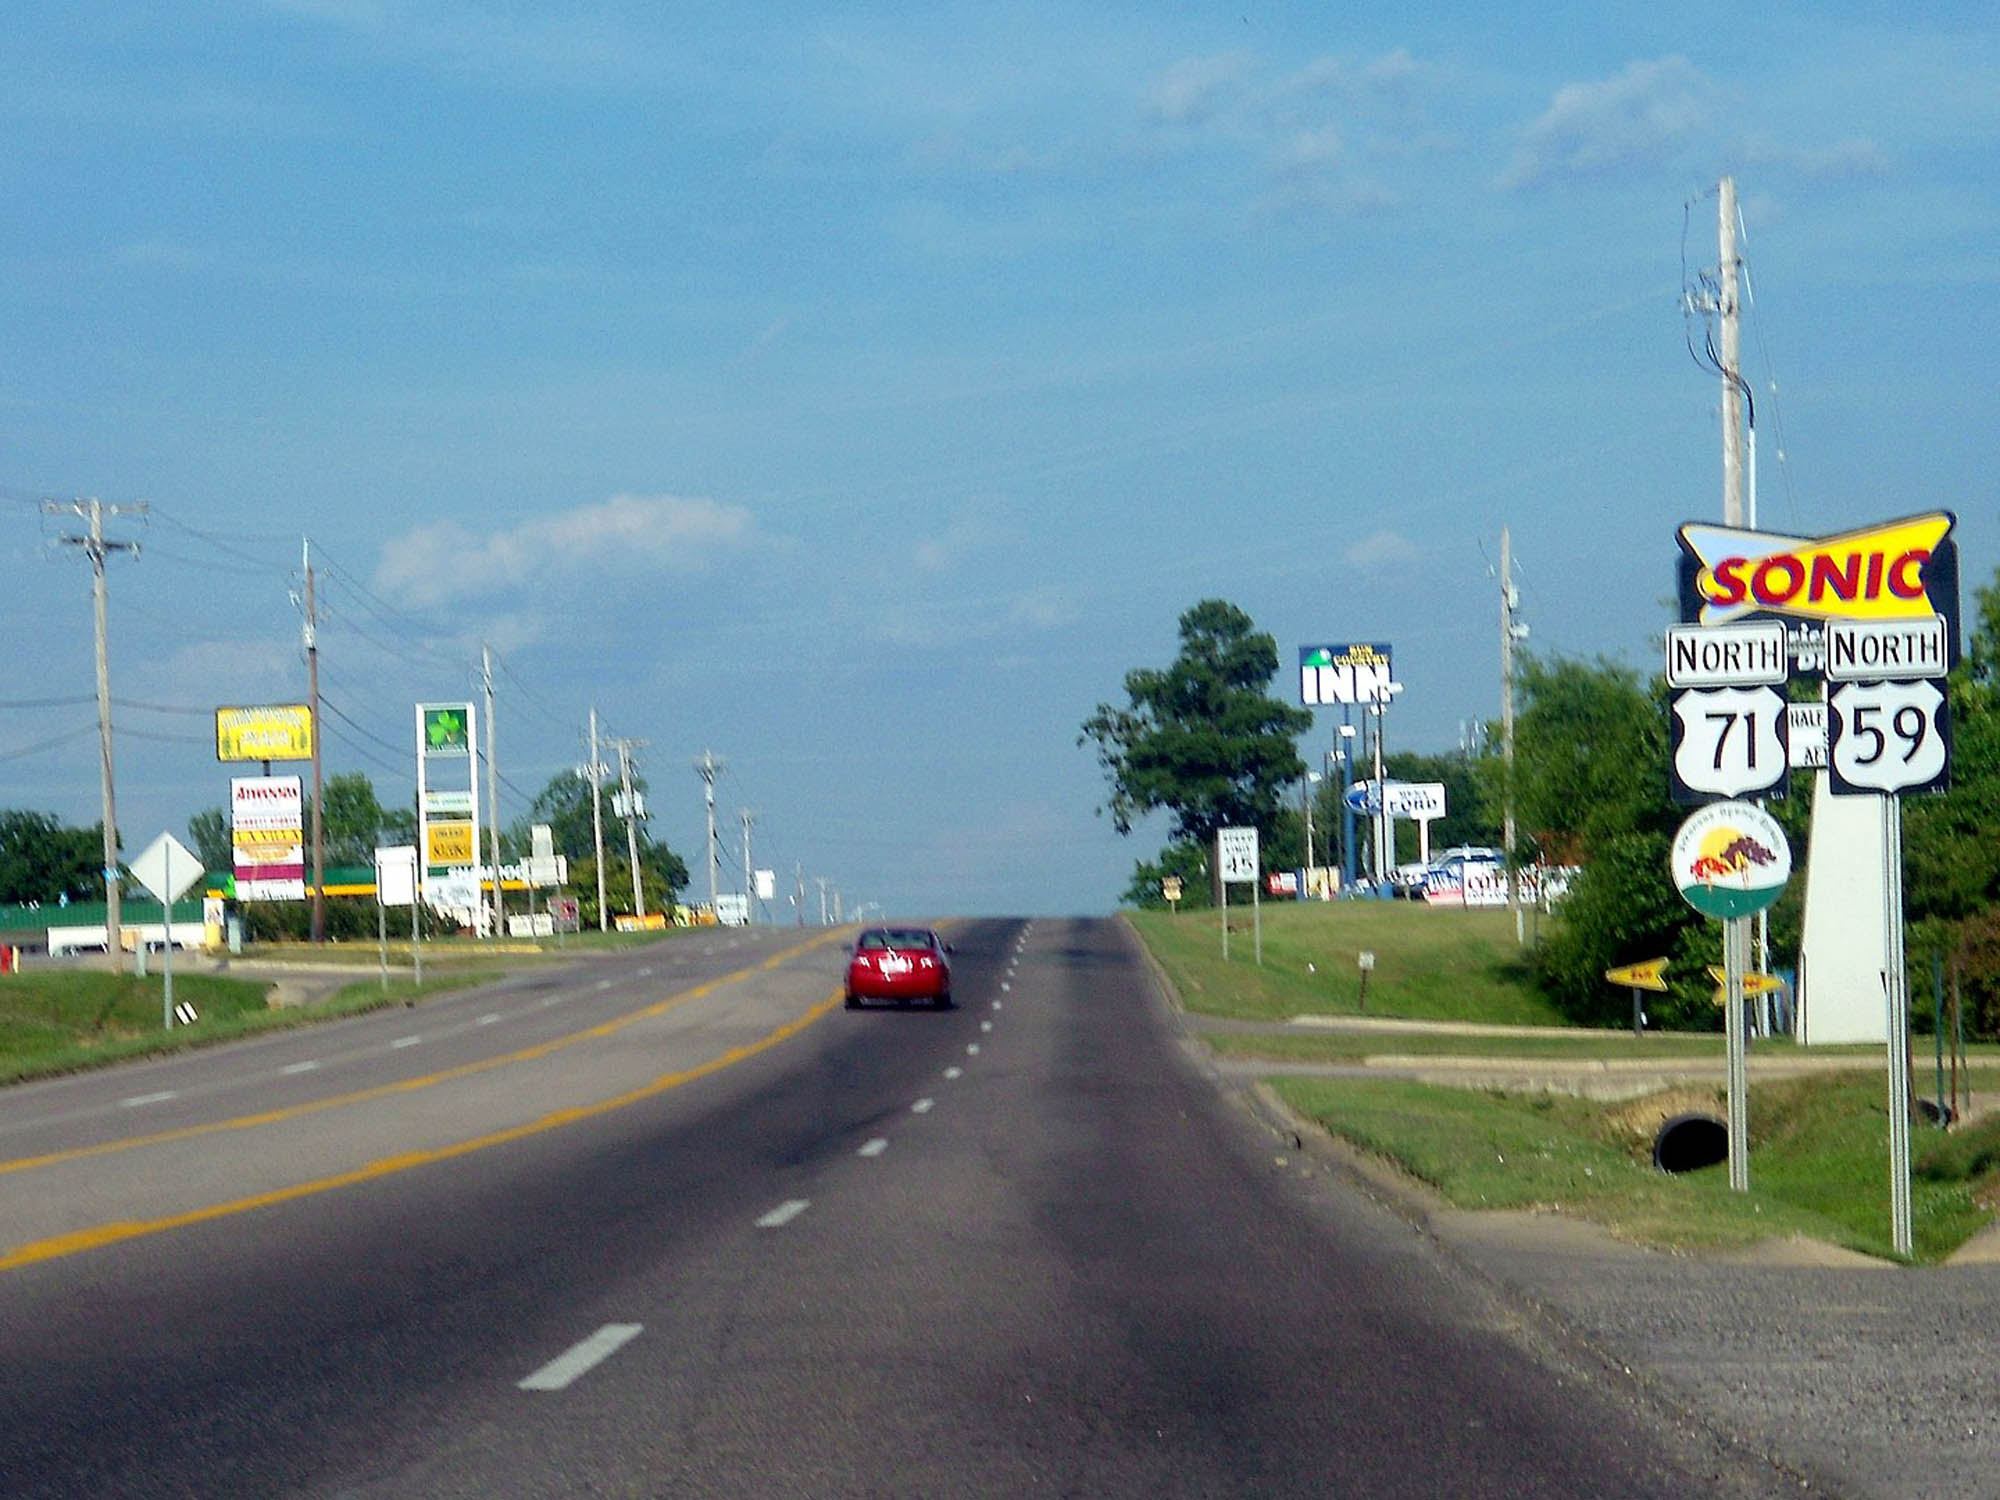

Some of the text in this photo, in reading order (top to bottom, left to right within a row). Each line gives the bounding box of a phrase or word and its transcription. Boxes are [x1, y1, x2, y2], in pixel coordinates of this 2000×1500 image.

[1708, 550, 1933, 606] SONIC
[1675, 639, 1779, 673] NORTH
[1827, 632, 1939, 666] NORTH
[1302, 664, 1390, 705] INN
[1705, 711, 1757, 770] 71
[1853, 706, 1927, 764] 59
[1388, 799, 1438, 813] FORD
